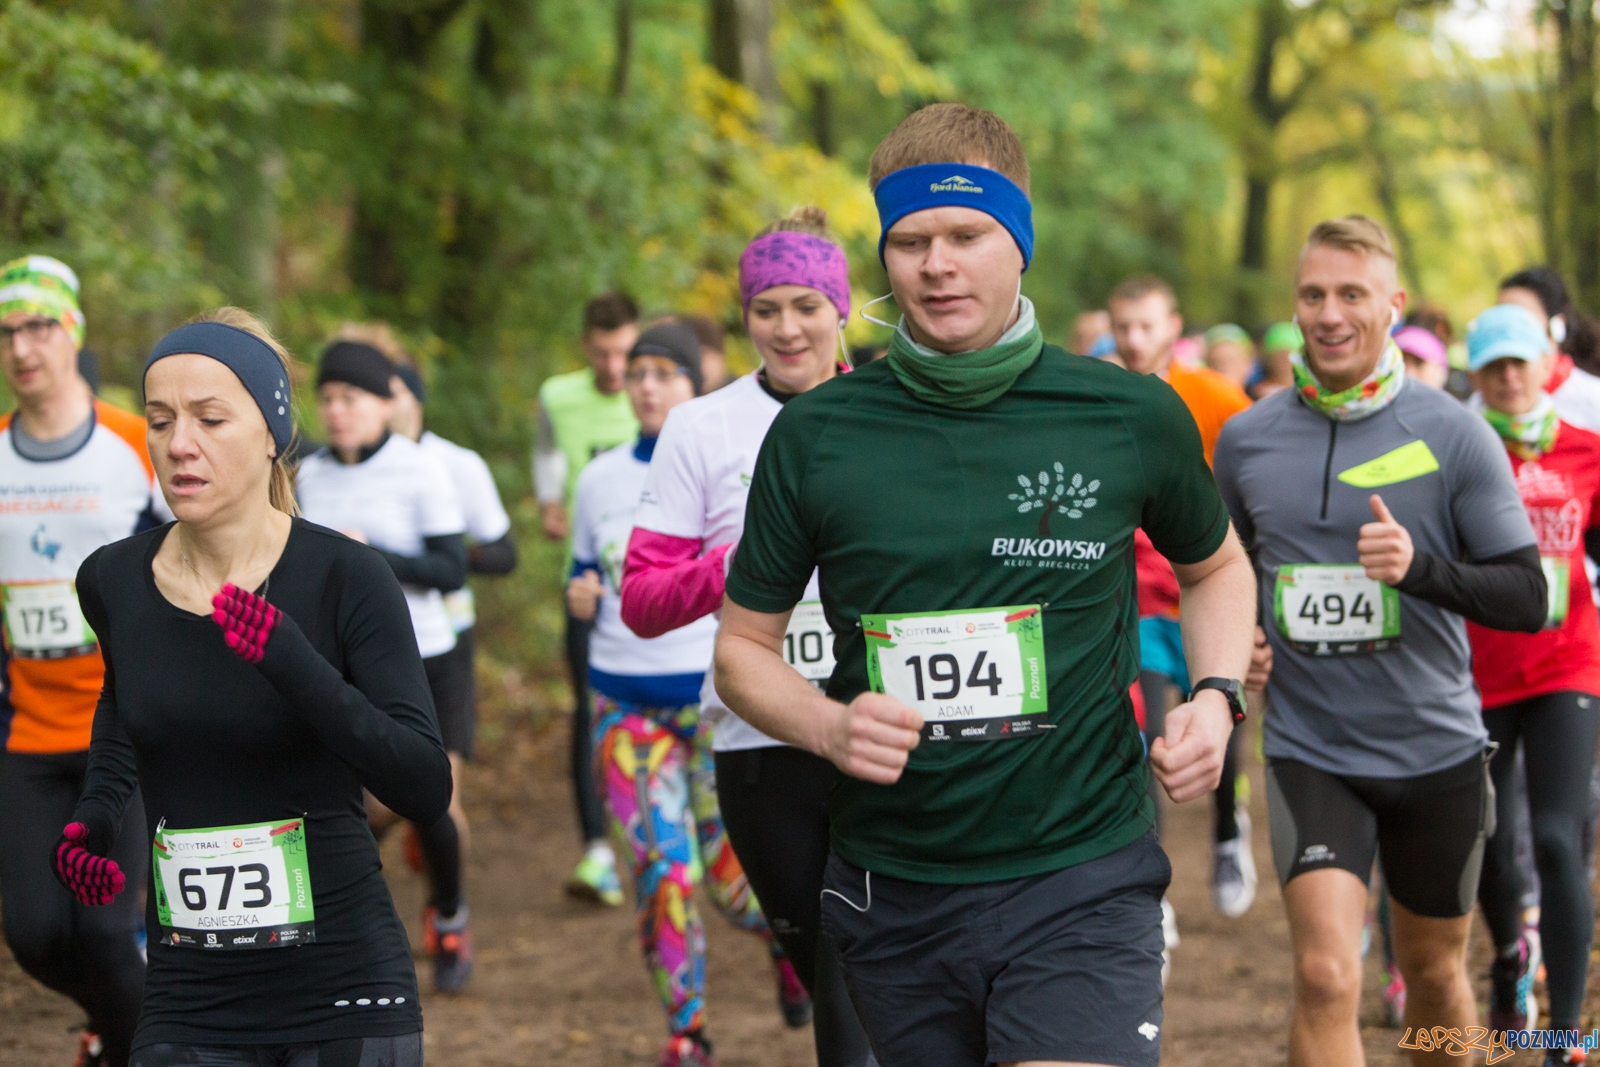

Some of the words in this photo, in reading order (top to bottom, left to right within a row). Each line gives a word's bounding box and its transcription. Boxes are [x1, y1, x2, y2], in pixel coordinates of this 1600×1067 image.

[991, 538, 1106, 560] BUKOWSKI
[1003, 559, 1032, 567] KLUB
[1038, 560, 1090, 570] BIEGACZA
[20, 606, 68, 635] 175
[1299, 592, 1374, 625] 494
[784, 630, 836, 664] 10
[905, 650, 1002, 701] 194
[1027, 657, 1040, 700] Poznań
[938, 705, 974, 718] ADAM
[178, 863, 272, 911] 673
[292, 868, 306, 908] Poznań
[198, 914, 260, 927] AGNIESZKA
